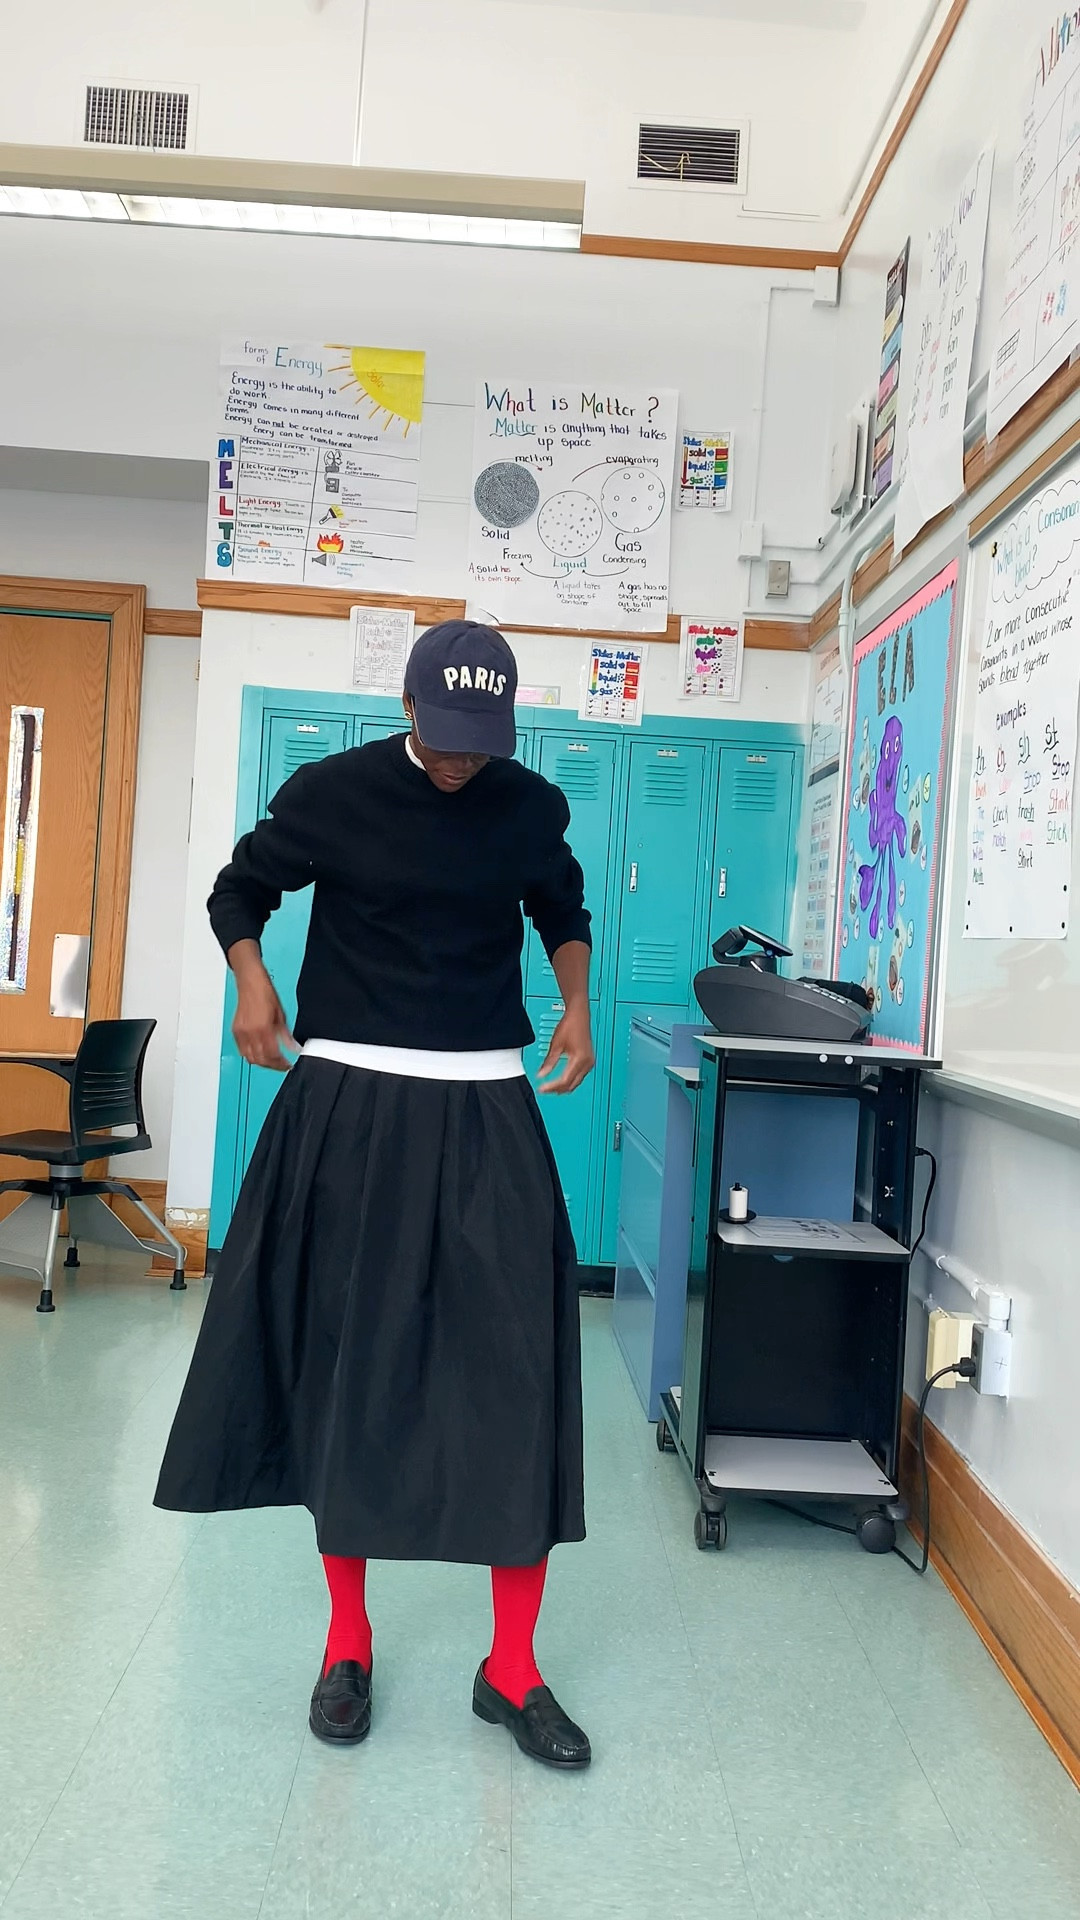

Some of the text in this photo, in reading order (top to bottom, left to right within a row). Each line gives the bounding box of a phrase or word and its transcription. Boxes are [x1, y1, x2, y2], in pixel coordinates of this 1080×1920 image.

[256, 355, 266, 364] of
[275, 346, 323, 377] Energy
[230, 387, 240, 395] do
[232, 371, 265, 391] Energy
[281, 381, 295, 390] the
[297, 385, 323, 399] ability
[328, 387, 337, 395] to
[228, 395, 257, 409] Energy
[263, 403, 287, 412] comes
[301, 408, 323, 418] many
[326, 410, 359, 420] different
[485, 382, 660, 423] What is Matter ?
[225, 413, 252, 425] Energy
[302, 425, 333, 435] created
[347, 432, 378, 441] destroyed
[495, 418, 667, 440] Matter is anything that takes
[538, 437, 592, 451] up space
[689, 448, 706, 457] solid
[515, 454, 553, 466] melting
[606, 456, 659, 467] evaporating
[688, 461, 707, 473] liquid
[690, 477, 704, 485] gas
[239, 496, 256, 507] Light
[481, 526, 510, 540] Solid
[614, 532, 642, 552] Gas
[503, 547, 533, 563] Freezing
[602, 554, 647, 568] Condensing
[468, 562, 475, 573] A
[553, 555, 587, 572] Liquid
[553, 580, 601, 592] A liquid takes
[619, 581, 625, 590] A
[627, 584, 642, 594] gas
[644, 582, 657, 590] has
[986, 620, 993, 648] 2
[994, 628, 1002, 642] or
[1004, 615, 1020, 637] more
[592, 648, 641, 661] States Matter
[1012, 643, 1018, 656] in
[1021, 639, 1025, 651] a
[600, 660, 617, 669] solid
[878, 626, 914, 716] ELA
[1000, 661, 1020, 682] blend
[443, 665, 507, 696] PARIS
[599, 672, 617, 684] liquid
[599, 688, 613, 696] gas
[996, 699, 1026, 730] examples
